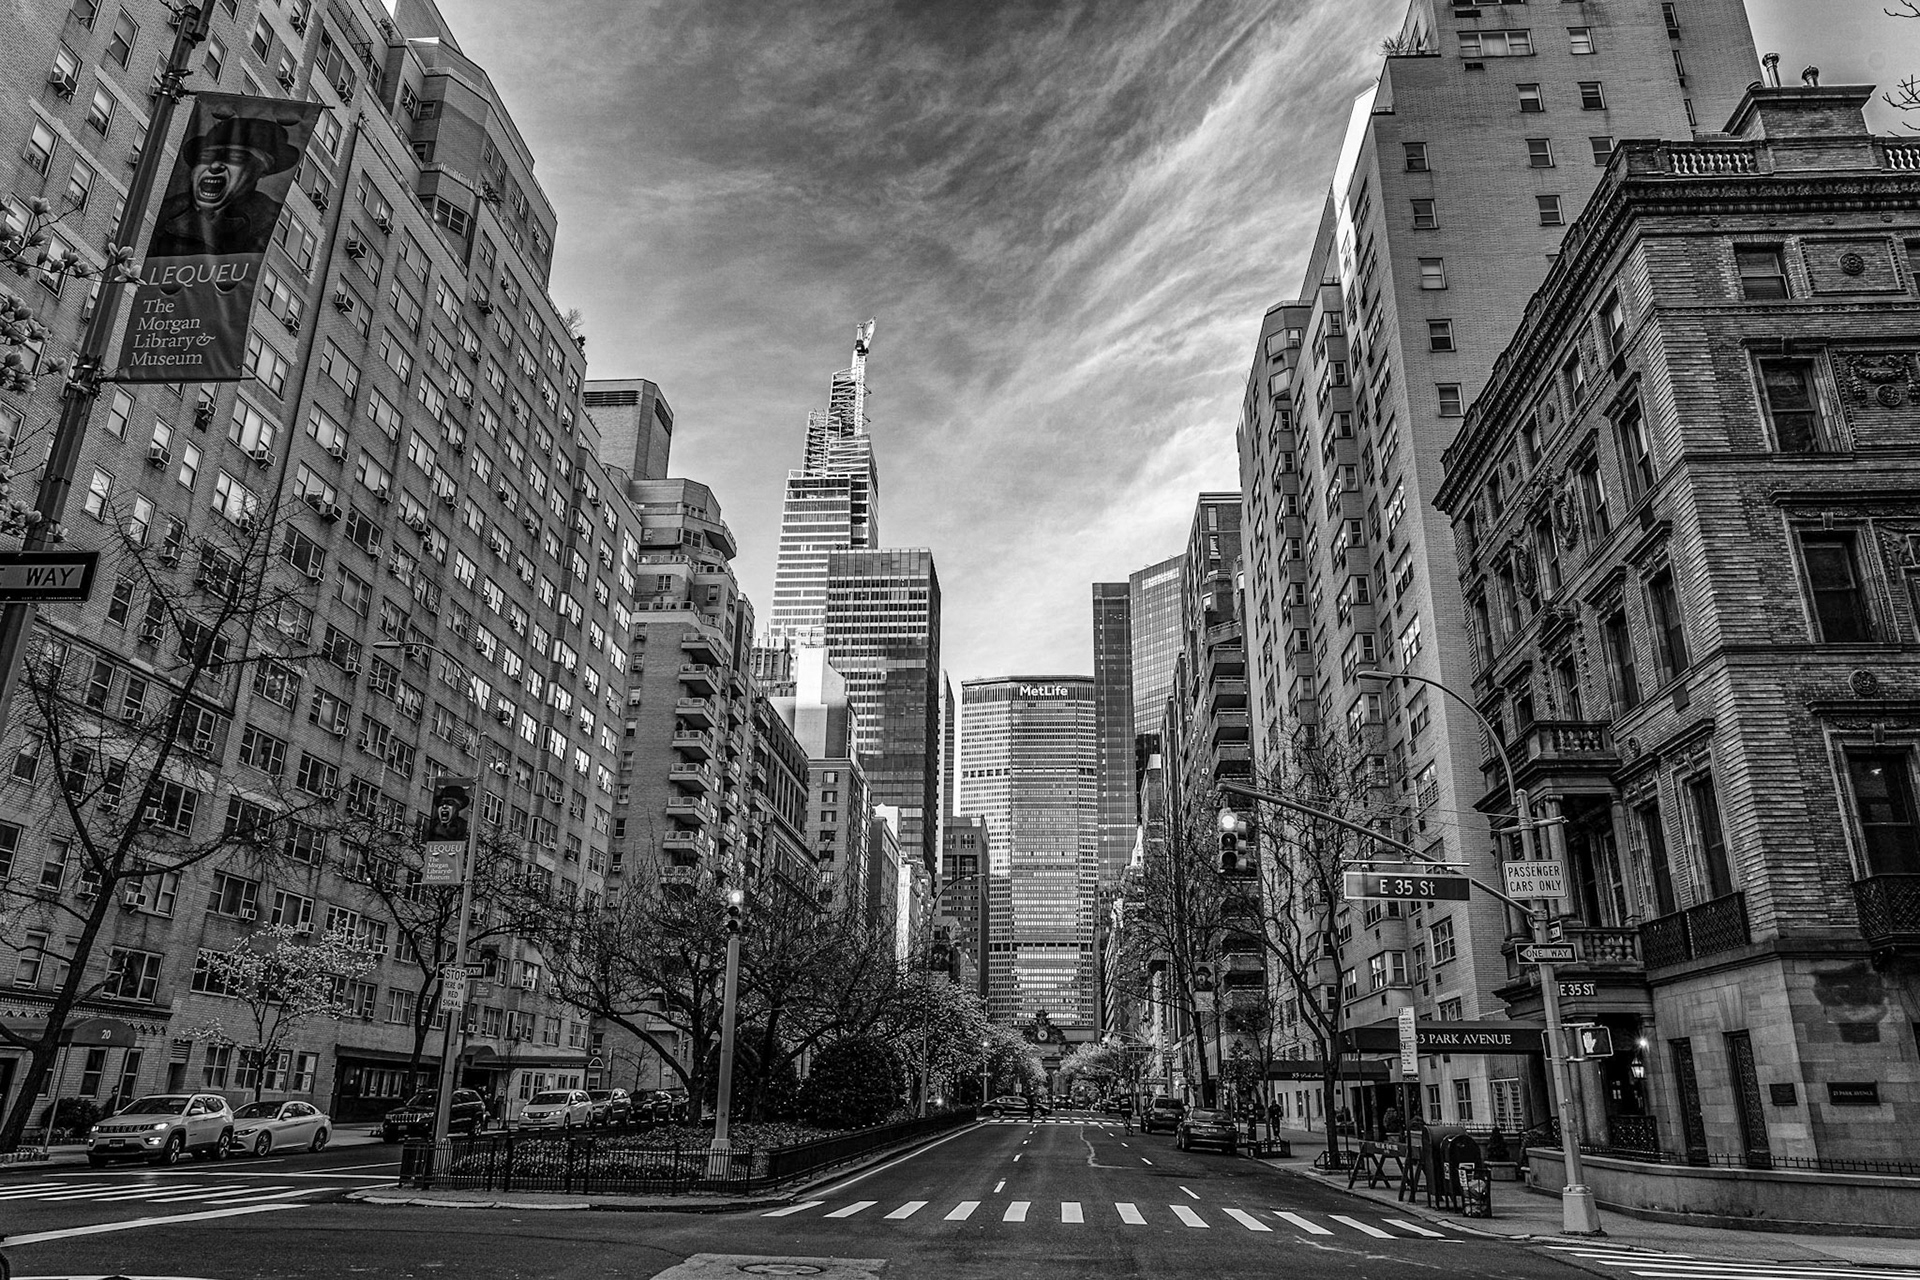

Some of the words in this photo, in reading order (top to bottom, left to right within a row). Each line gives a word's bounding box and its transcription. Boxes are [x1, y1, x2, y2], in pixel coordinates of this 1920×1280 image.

[149, 262, 249, 287] LEQUEU
[143, 299, 175, 313] The
[137, 317, 200, 334] Morgan
[133, 333, 195, 351] Library
[130, 352, 203, 366] Museum
[26, 567, 76, 586] WAY
[1020, 685, 1068, 696] MetLife
[429, 844, 462, 853] LEQUEU
[1507, 865, 1560, 877] PASSENGER
[1380, 879, 1388, 894] E
[1394, 879, 1413, 895] 35
[1420, 880, 1435, 896] St
[1509, 880, 1534, 892] CARS
[1539, 880, 1561, 891] ONLY
[1526, 949, 1543, 958] ONE
[1550, 949, 1568, 957] WAY
[445, 969, 466, 980] STOP
[1560, 984, 1567, 996] E
[1568, 983, 1581, 996] 35
[1583, 983, 1595, 995] ST
[101, 1029, 112, 1040] 20
[1429, 1033, 1460, 1044] PARK
[1462, 1034, 1512, 1045] AVENUE
